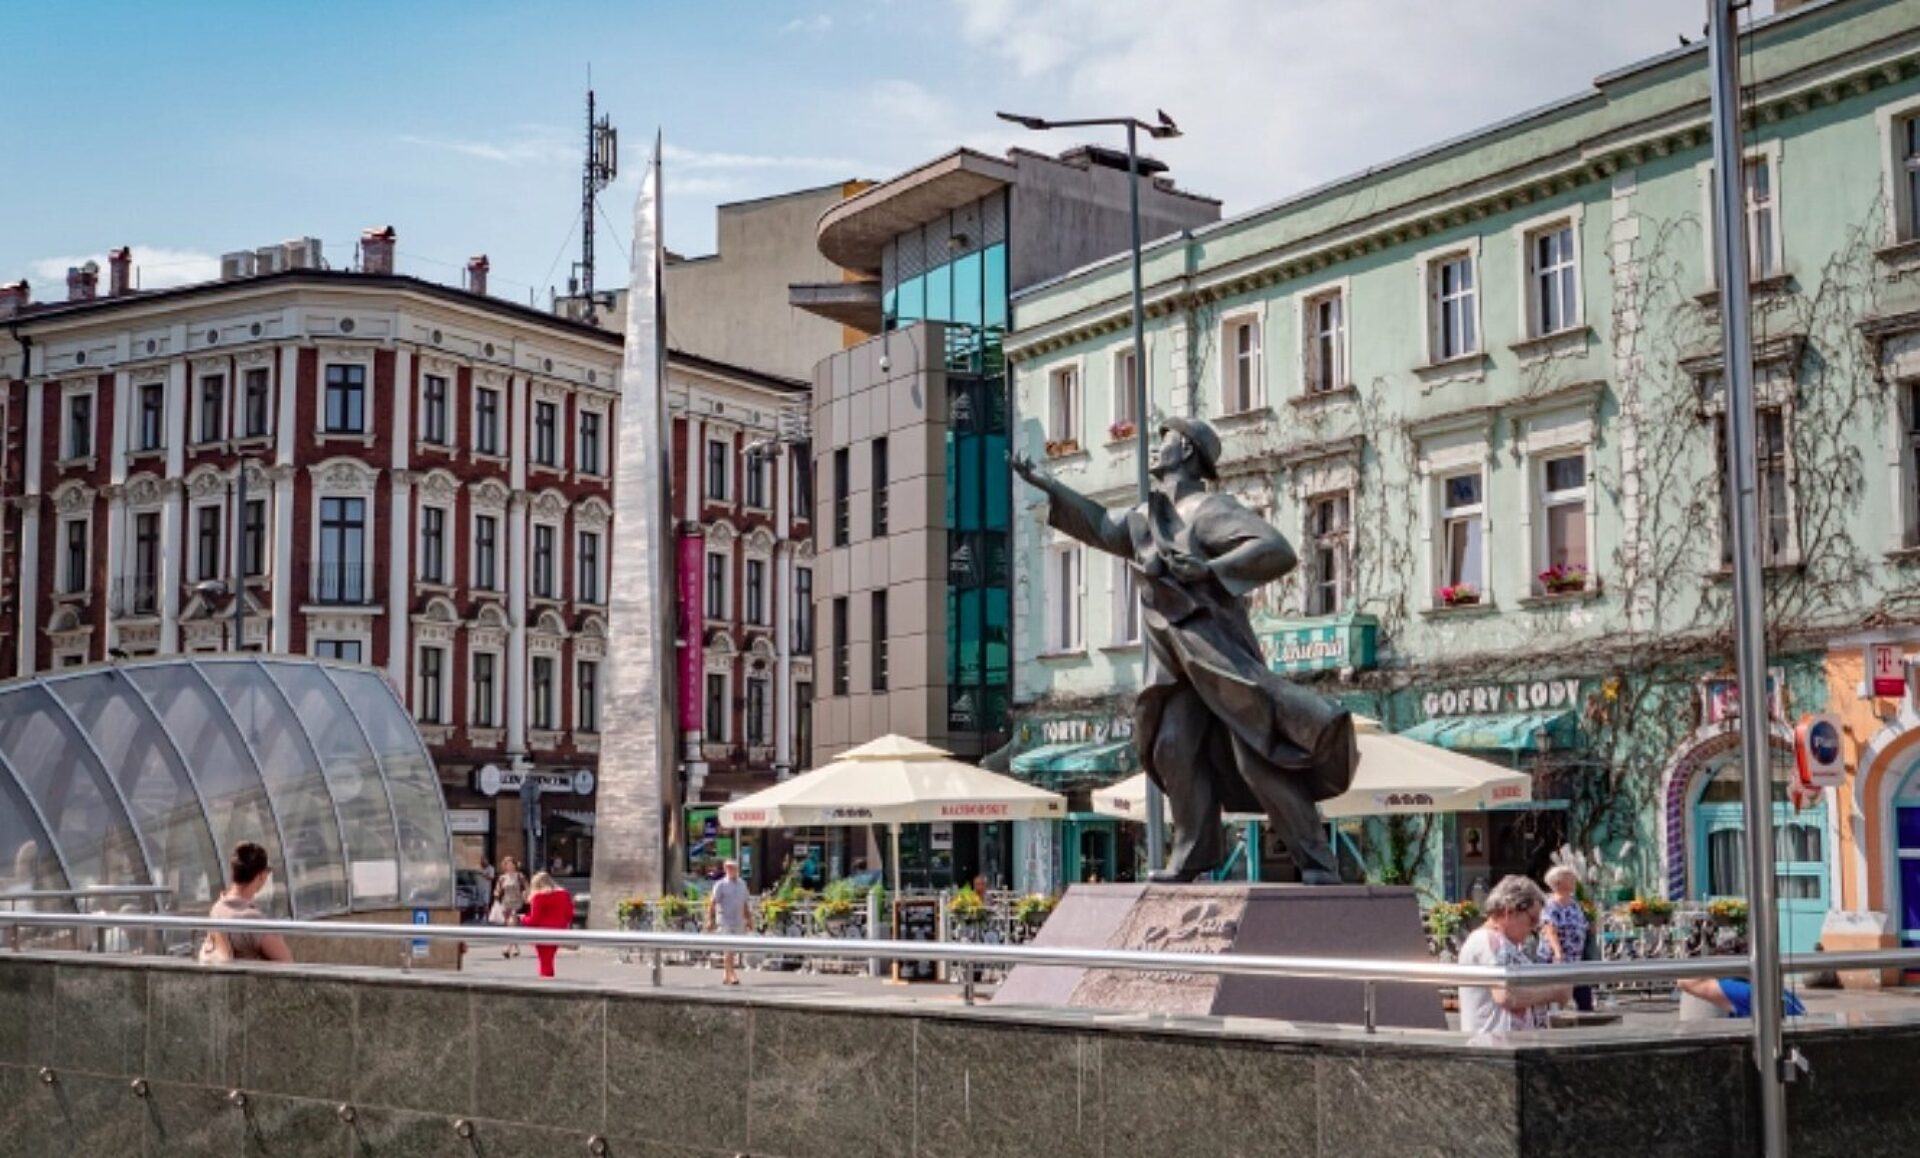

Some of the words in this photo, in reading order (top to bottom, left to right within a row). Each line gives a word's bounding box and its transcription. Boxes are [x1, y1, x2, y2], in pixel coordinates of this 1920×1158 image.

[1877, 648, 1892, 673] T
[1423, 686, 1501, 715] GOFRY
[1517, 679, 1580, 709] LODY
